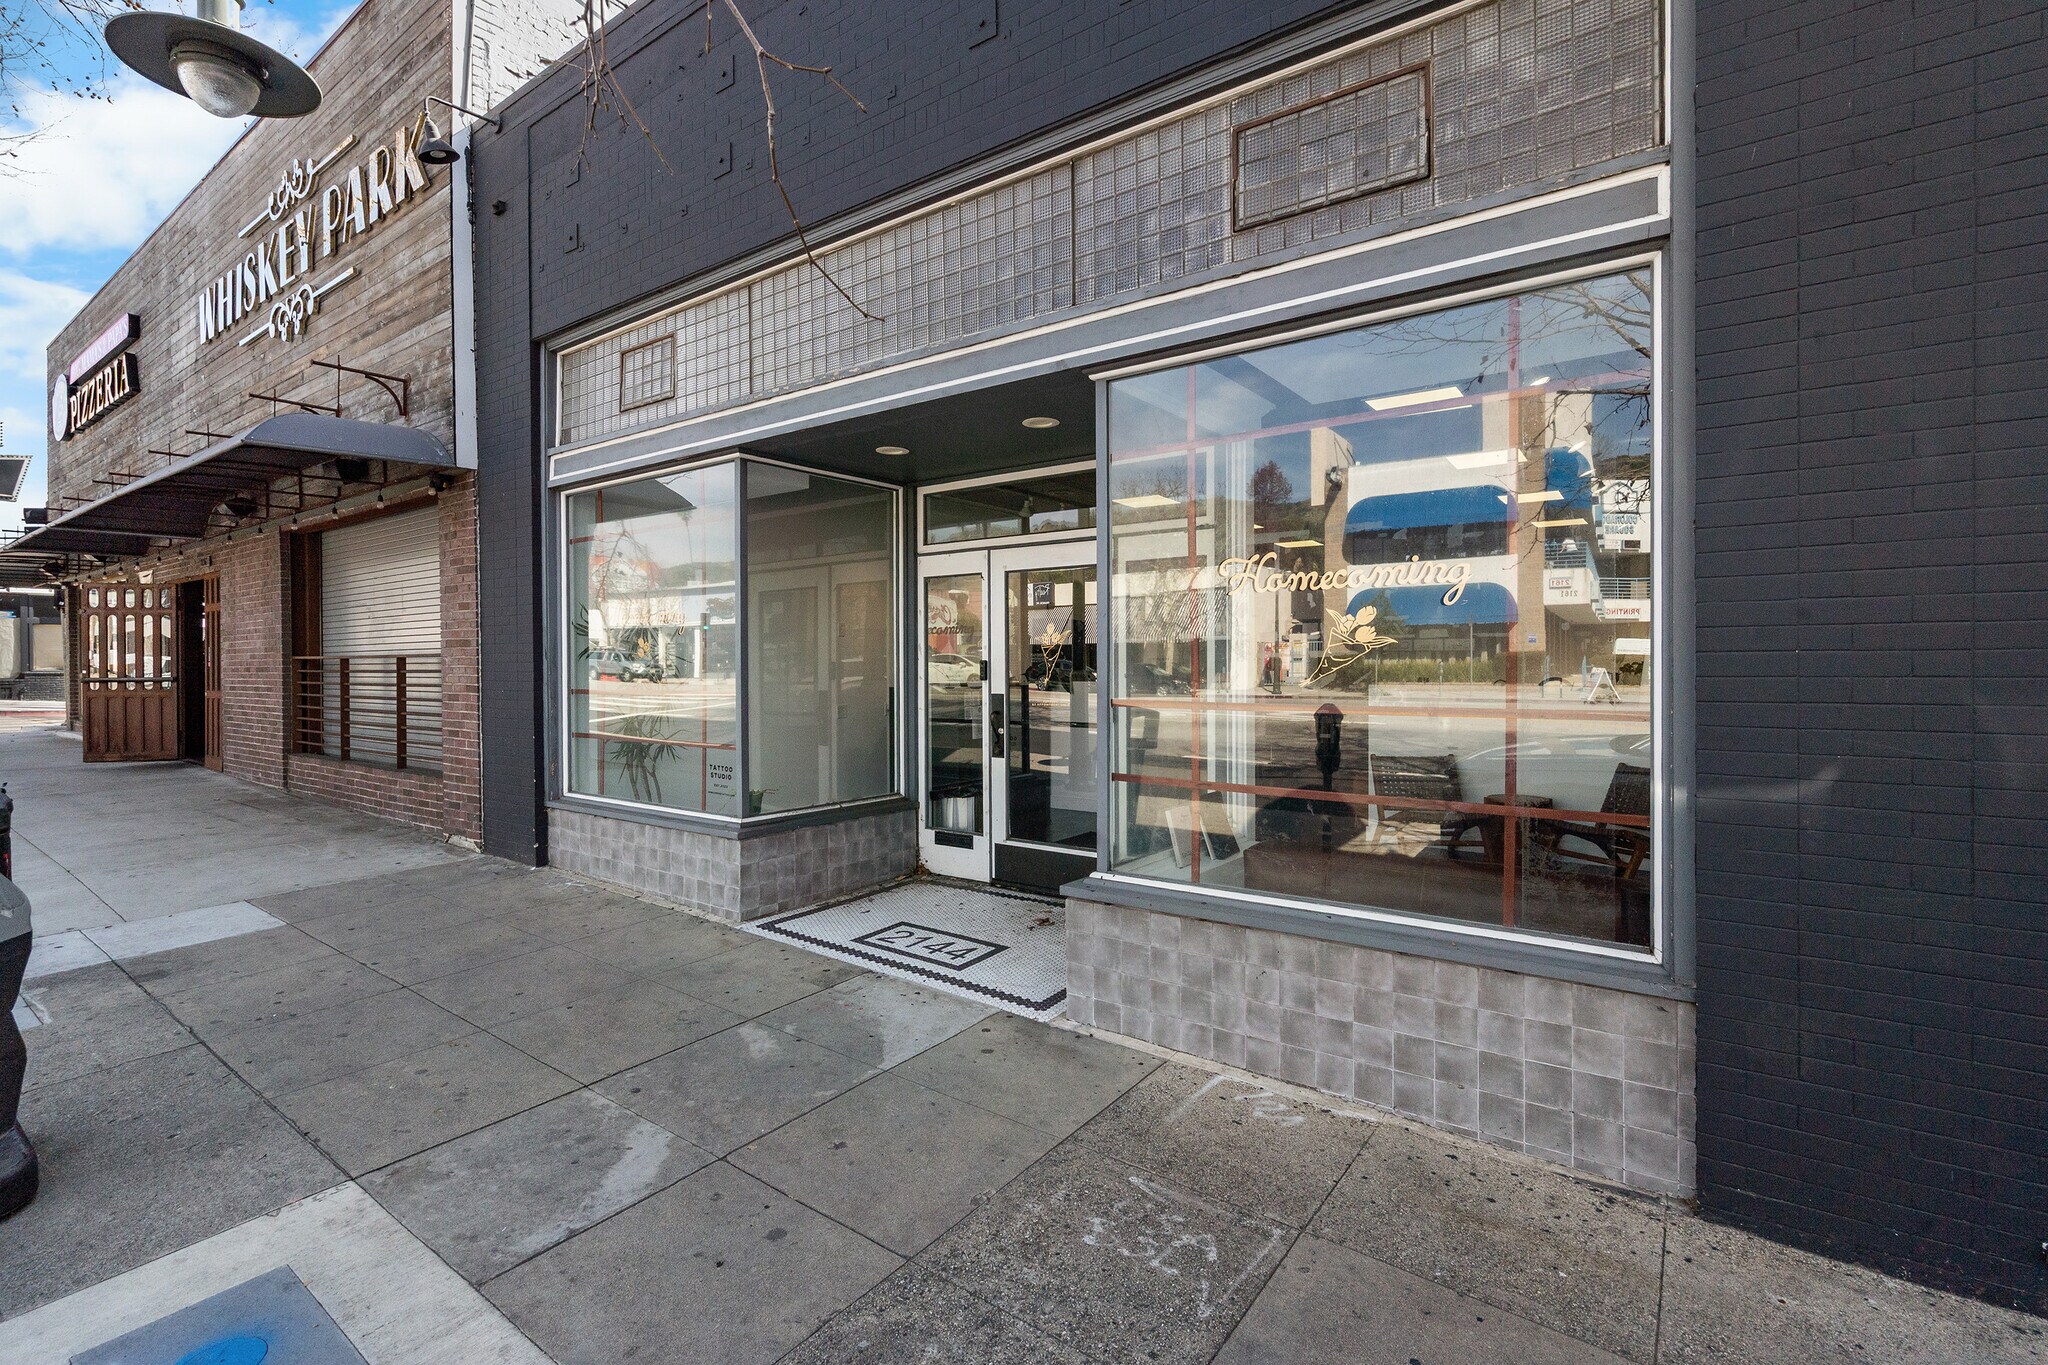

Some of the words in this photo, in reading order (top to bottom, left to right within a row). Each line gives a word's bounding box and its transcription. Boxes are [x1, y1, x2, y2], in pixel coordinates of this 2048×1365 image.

[199, 204, 316, 345] WHISKEY
[323, 111, 430, 257] PARK
[69, 351, 130, 433] PIZZERIA
[1218, 552, 1474, 606] Homecoming
[709, 764, 733, 773] TATTOO
[710, 772, 732, 780] STUDIO
[876, 930, 979, 960] 2144
